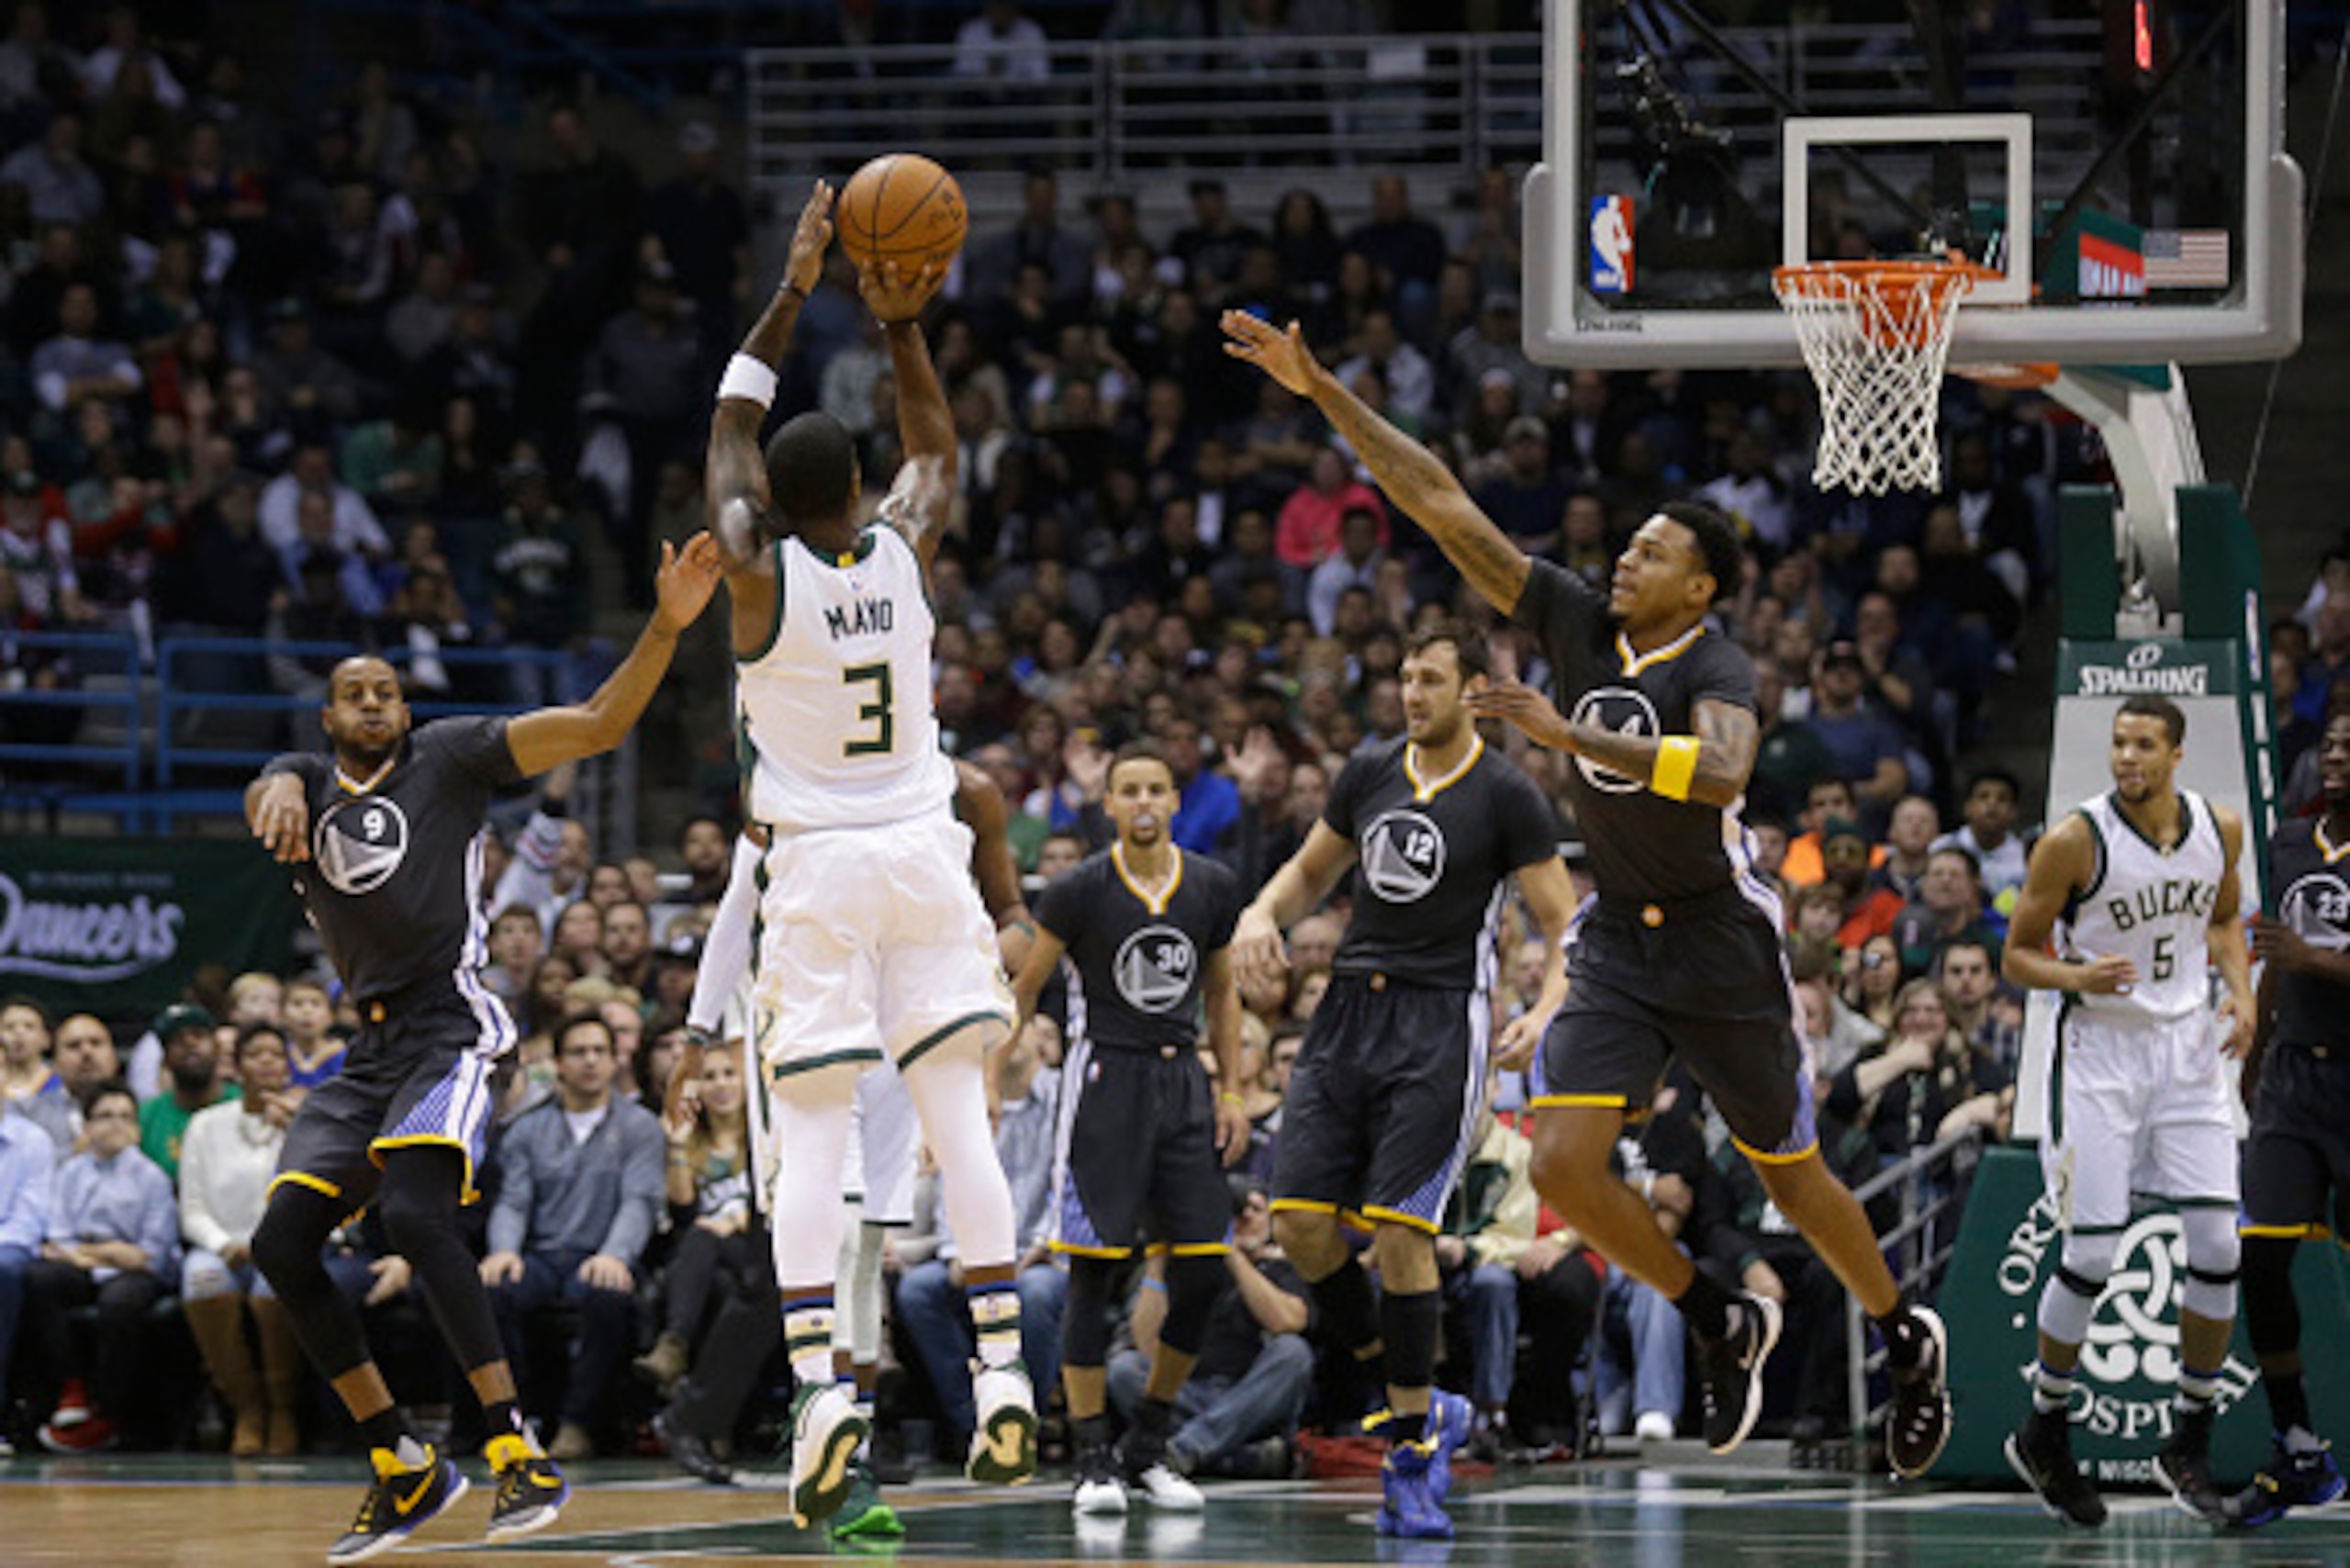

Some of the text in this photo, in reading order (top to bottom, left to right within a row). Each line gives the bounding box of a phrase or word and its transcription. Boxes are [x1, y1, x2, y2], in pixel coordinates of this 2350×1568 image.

[823, 598, 894, 640] MAYO
[2078, 663, 2208, 696] SPALDING
[843, 660, 895, 759] 3
[363, 809, 386, 841] 9
[1403, 830, 1436, 864] 12
[2317, 890, 2350, 921] 23
[1156, 943, 1190, 971] 30
[2153, 935, 2174, 981] 5
